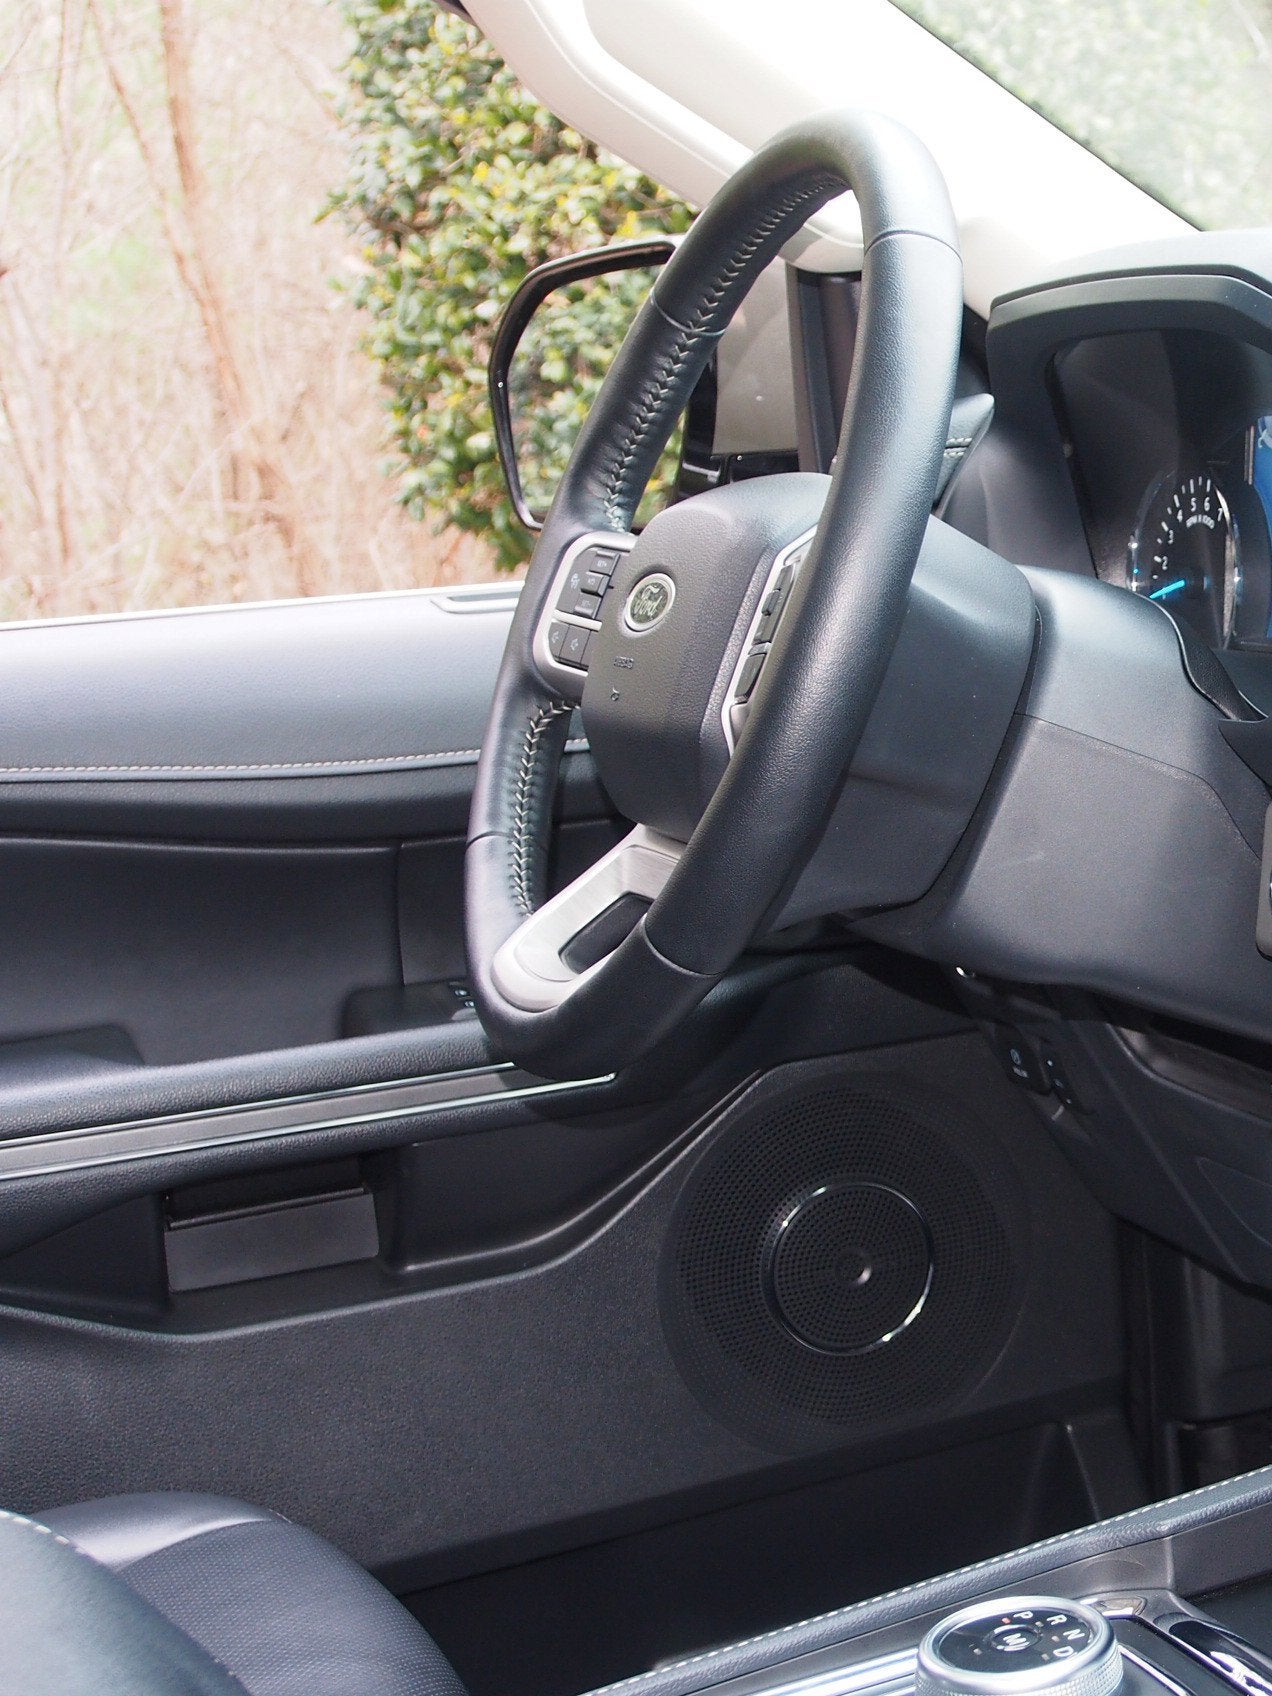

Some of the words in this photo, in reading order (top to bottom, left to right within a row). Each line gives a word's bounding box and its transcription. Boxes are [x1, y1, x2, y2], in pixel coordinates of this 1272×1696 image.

[1191, 497, 1197, 512] 5
[1204, 497, 1210, 511] 6
[1177, 509, 1183, 522] 4
[1168, 529, 1174, 544] 3
[1162, 556, 1168, 570] 2
[1013, 1611, 1034, 1619] P
[1046, 1614, 1067, 1626] R
[1063, 1628, 1085, 1640] N
[1053, 1645, 1074, 1657] D
